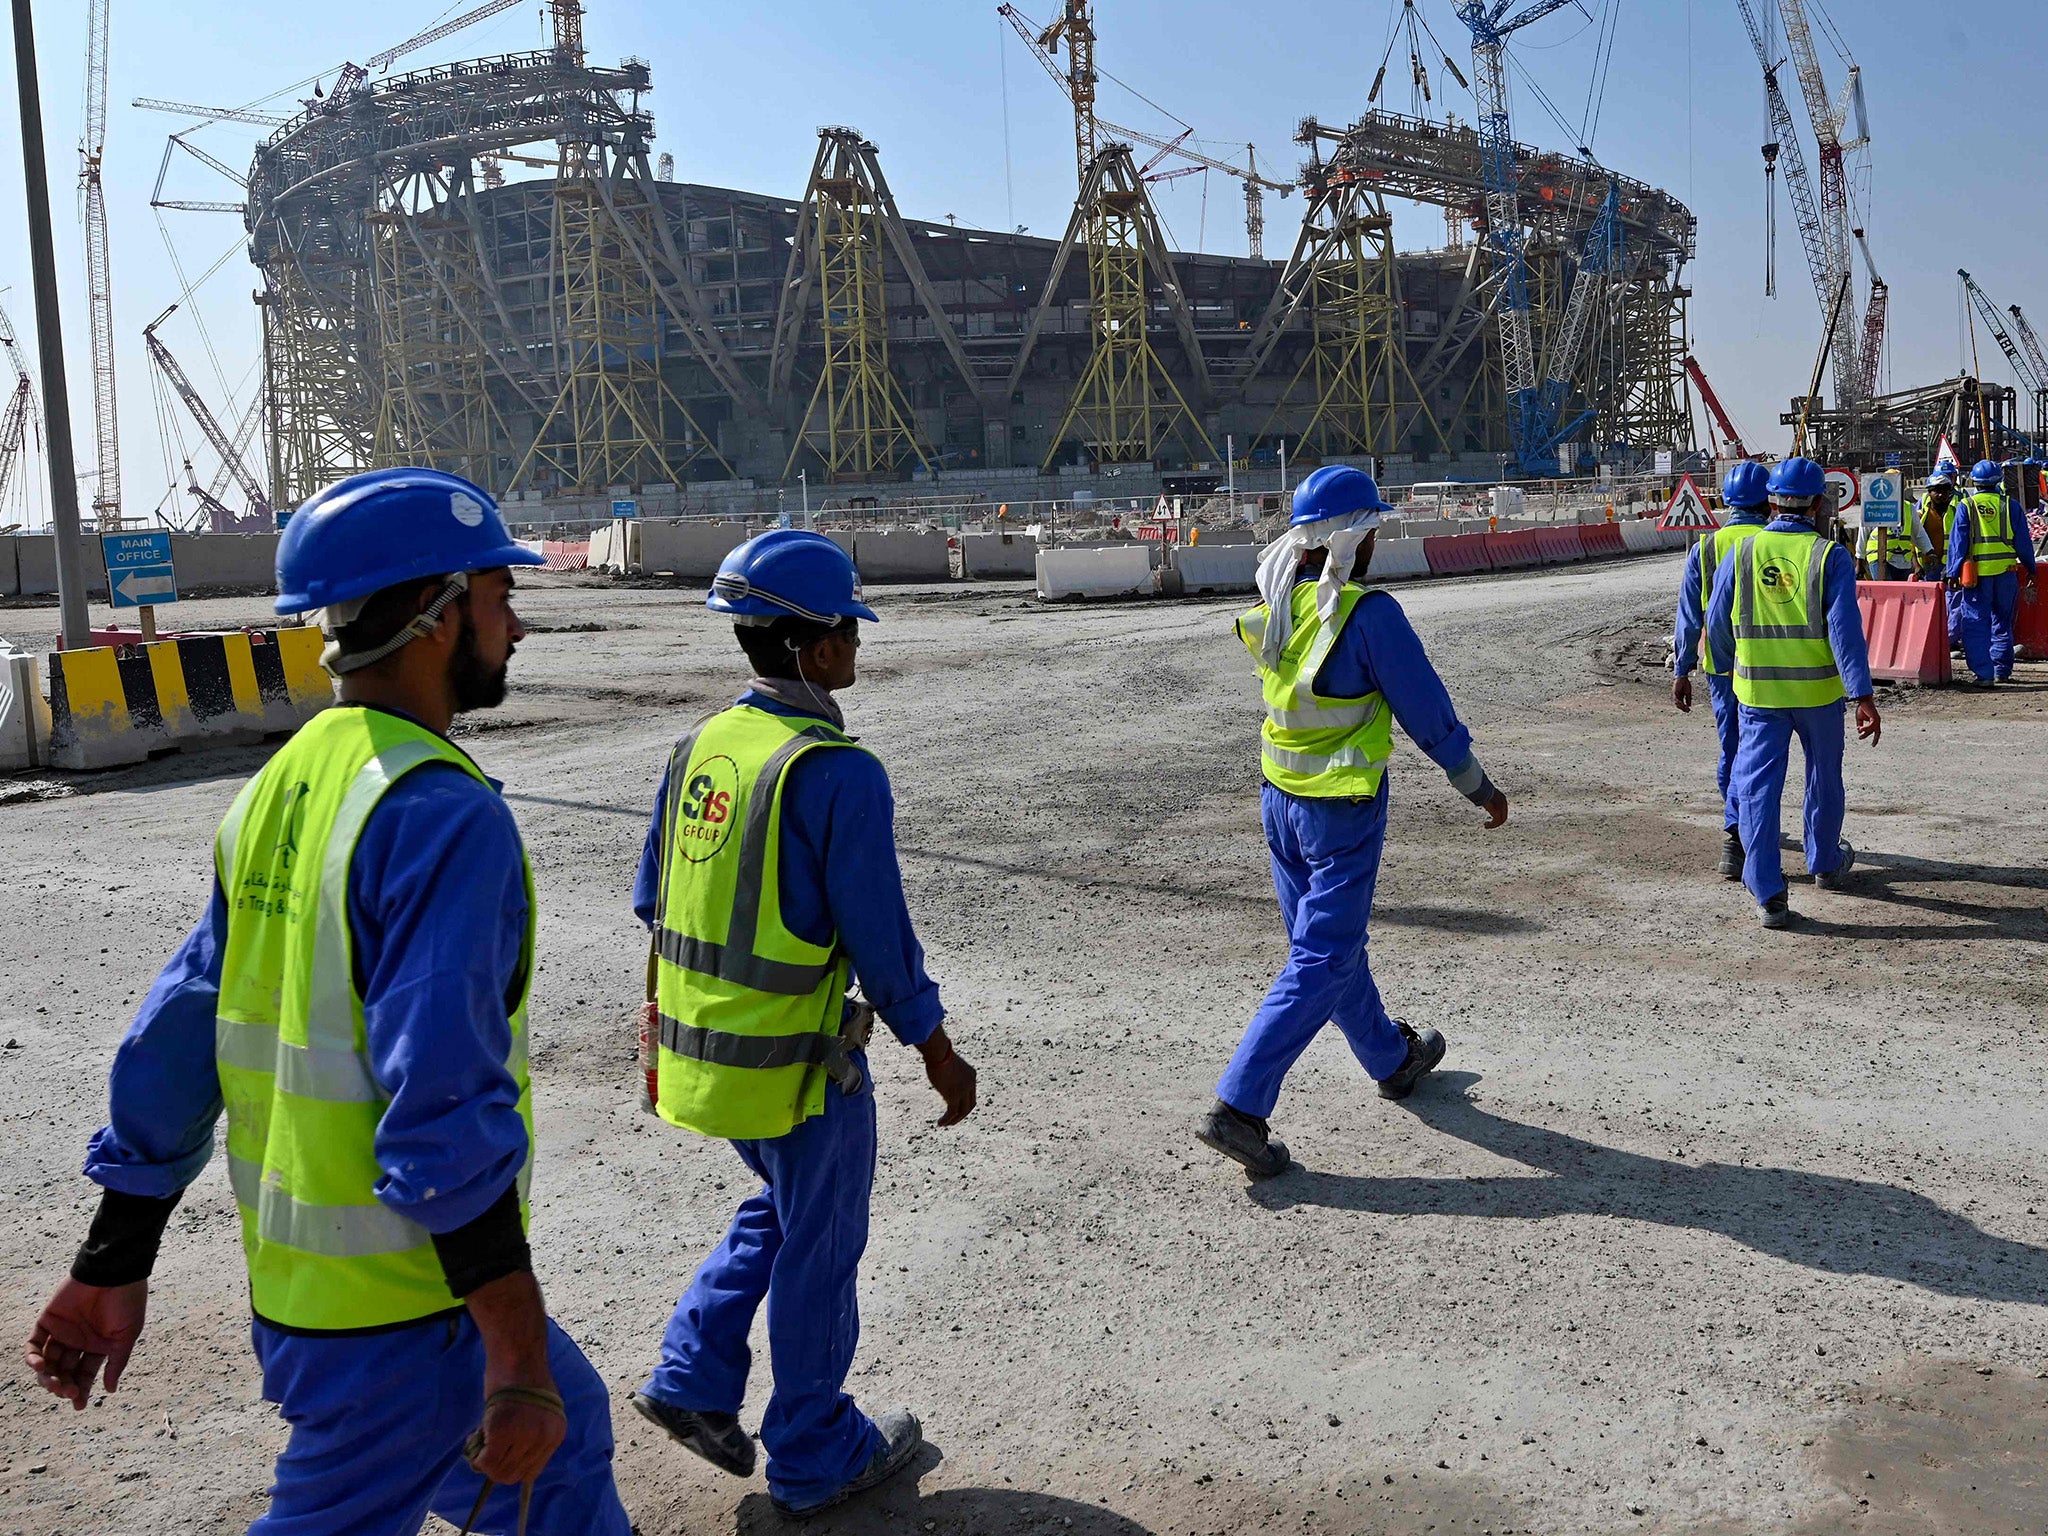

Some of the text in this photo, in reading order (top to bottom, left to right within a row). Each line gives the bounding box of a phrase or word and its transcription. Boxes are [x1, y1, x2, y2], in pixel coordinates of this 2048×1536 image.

[121, 538, 152, 549] MAIN
[116, 549, 161, 562] OFFICE
[683, 824, 720, 841] GROUP
